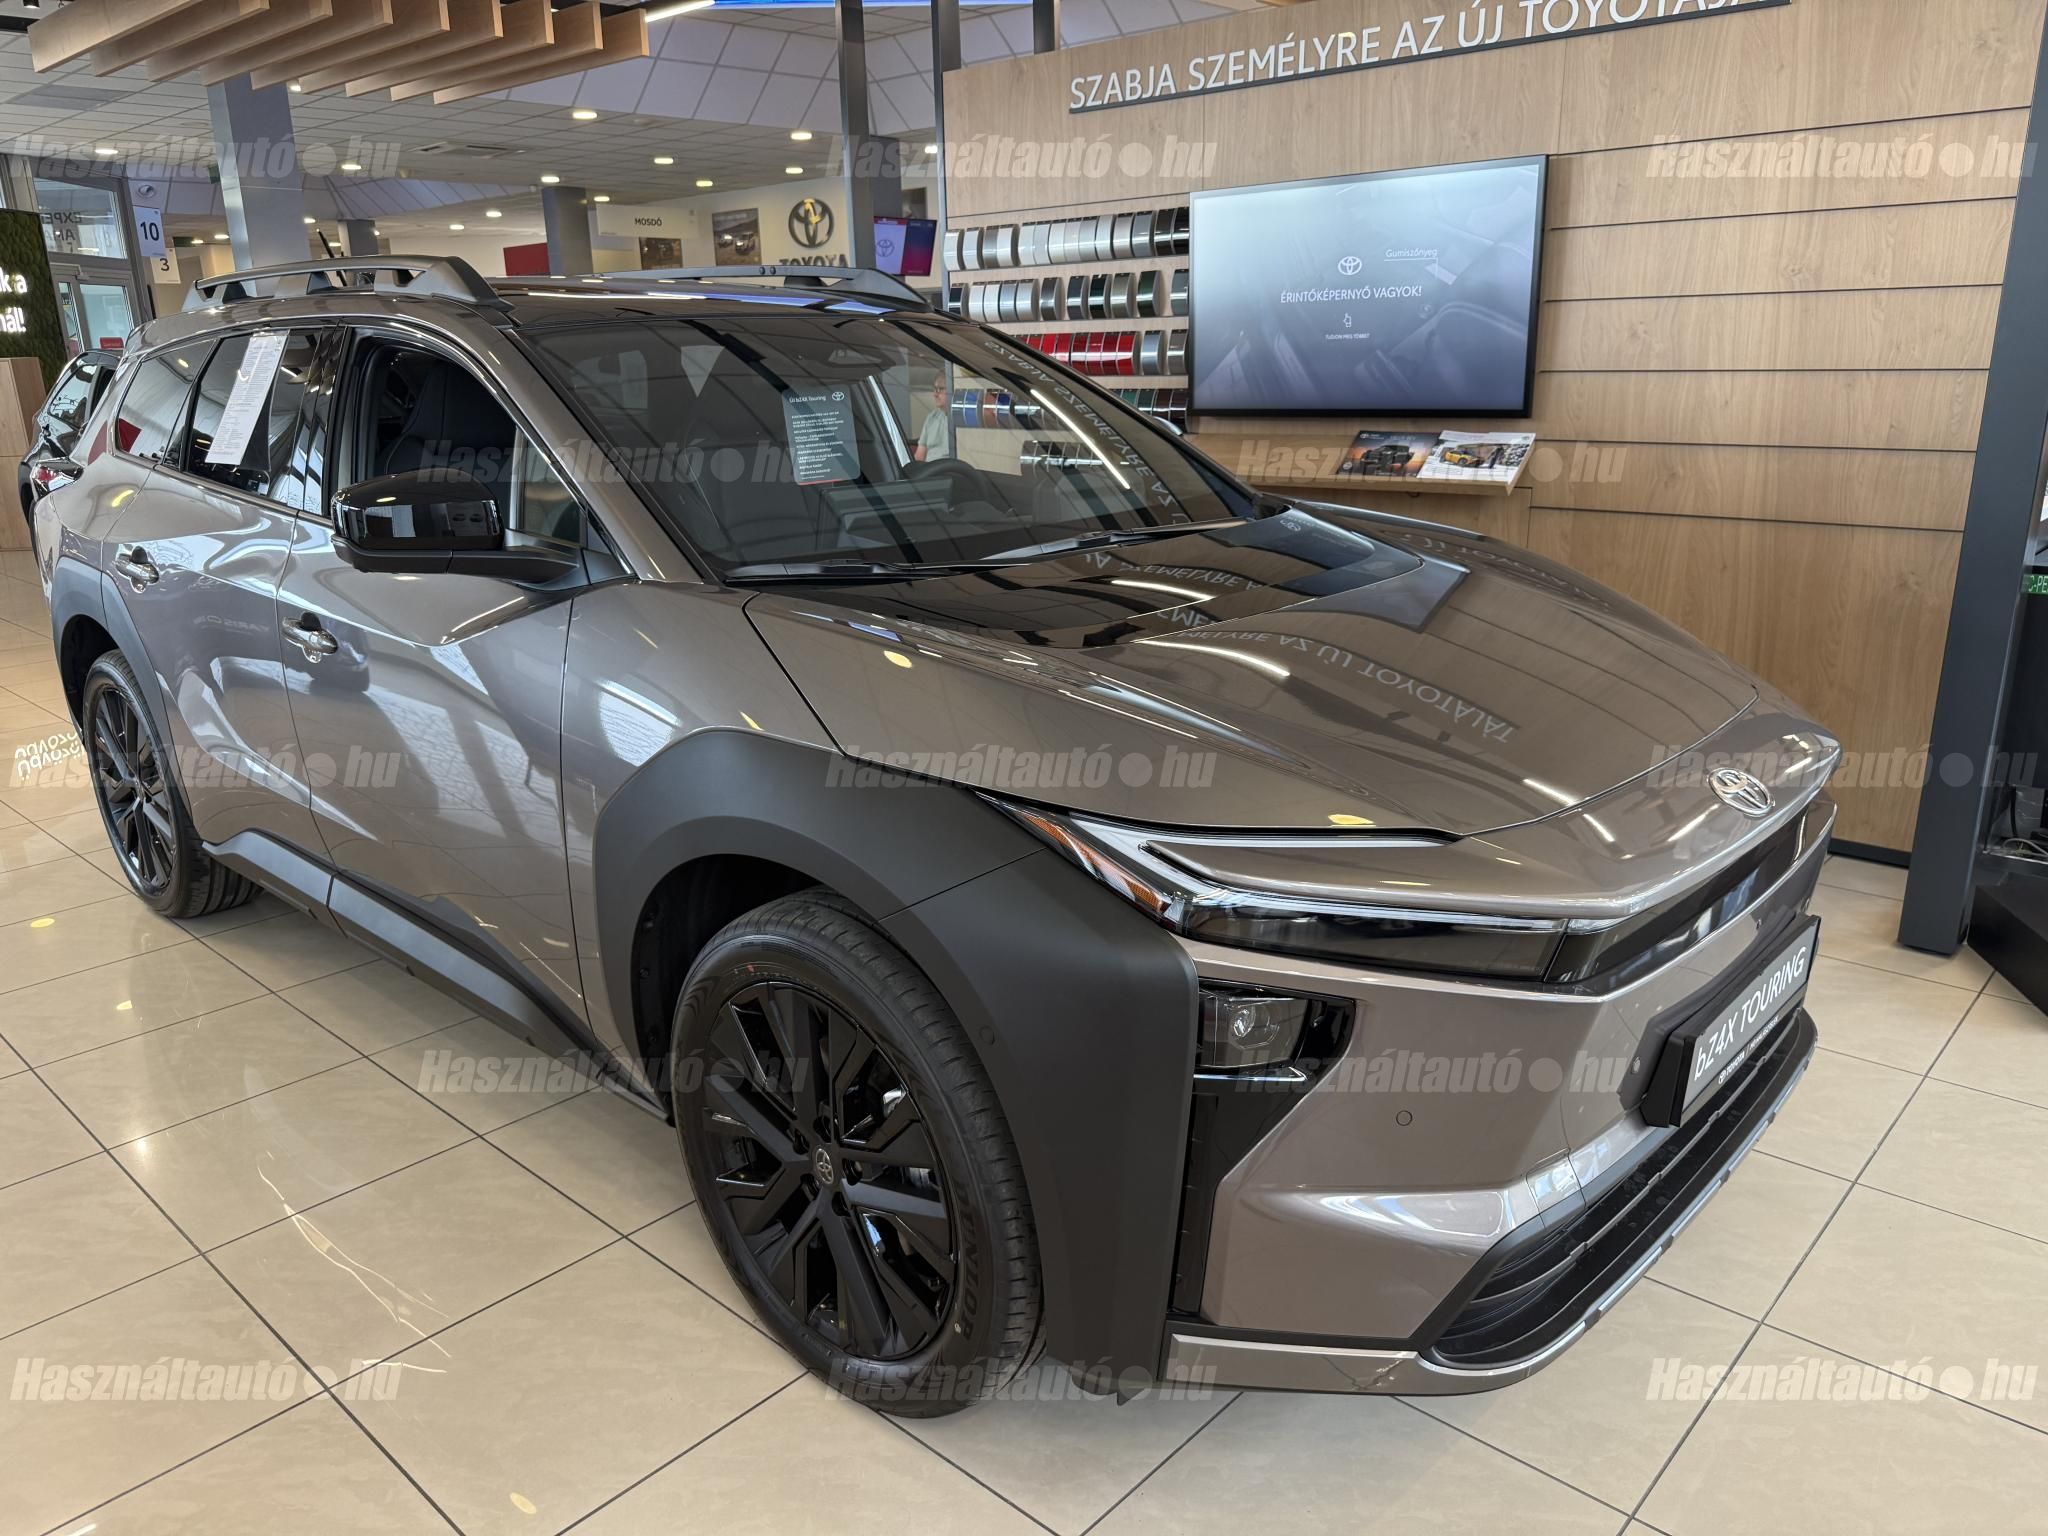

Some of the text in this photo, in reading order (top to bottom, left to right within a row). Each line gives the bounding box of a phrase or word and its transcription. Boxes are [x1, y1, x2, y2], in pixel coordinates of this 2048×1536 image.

[1069, 63, 1177, 109] SZABJA
[1188, 30, 1382, 91] SZEMÉLYRE
[1391, 15, 1445, 59] AZ
[1457, 2, 1504, 48] ÚJ
[140, 221, 160, 242] 10
[634, 217, 662, 227] MOSDÓ
[160, 257, 170, 272] 3
[15, 274, 28, 294] a
[1280, 285, 1422, 304] ÉRINTŐKÉPERNYŐ VAGYOK!
[1694, 1011, 1738, 1081] bZ4X
[1740, 946, 1806, 1033] TOURING
